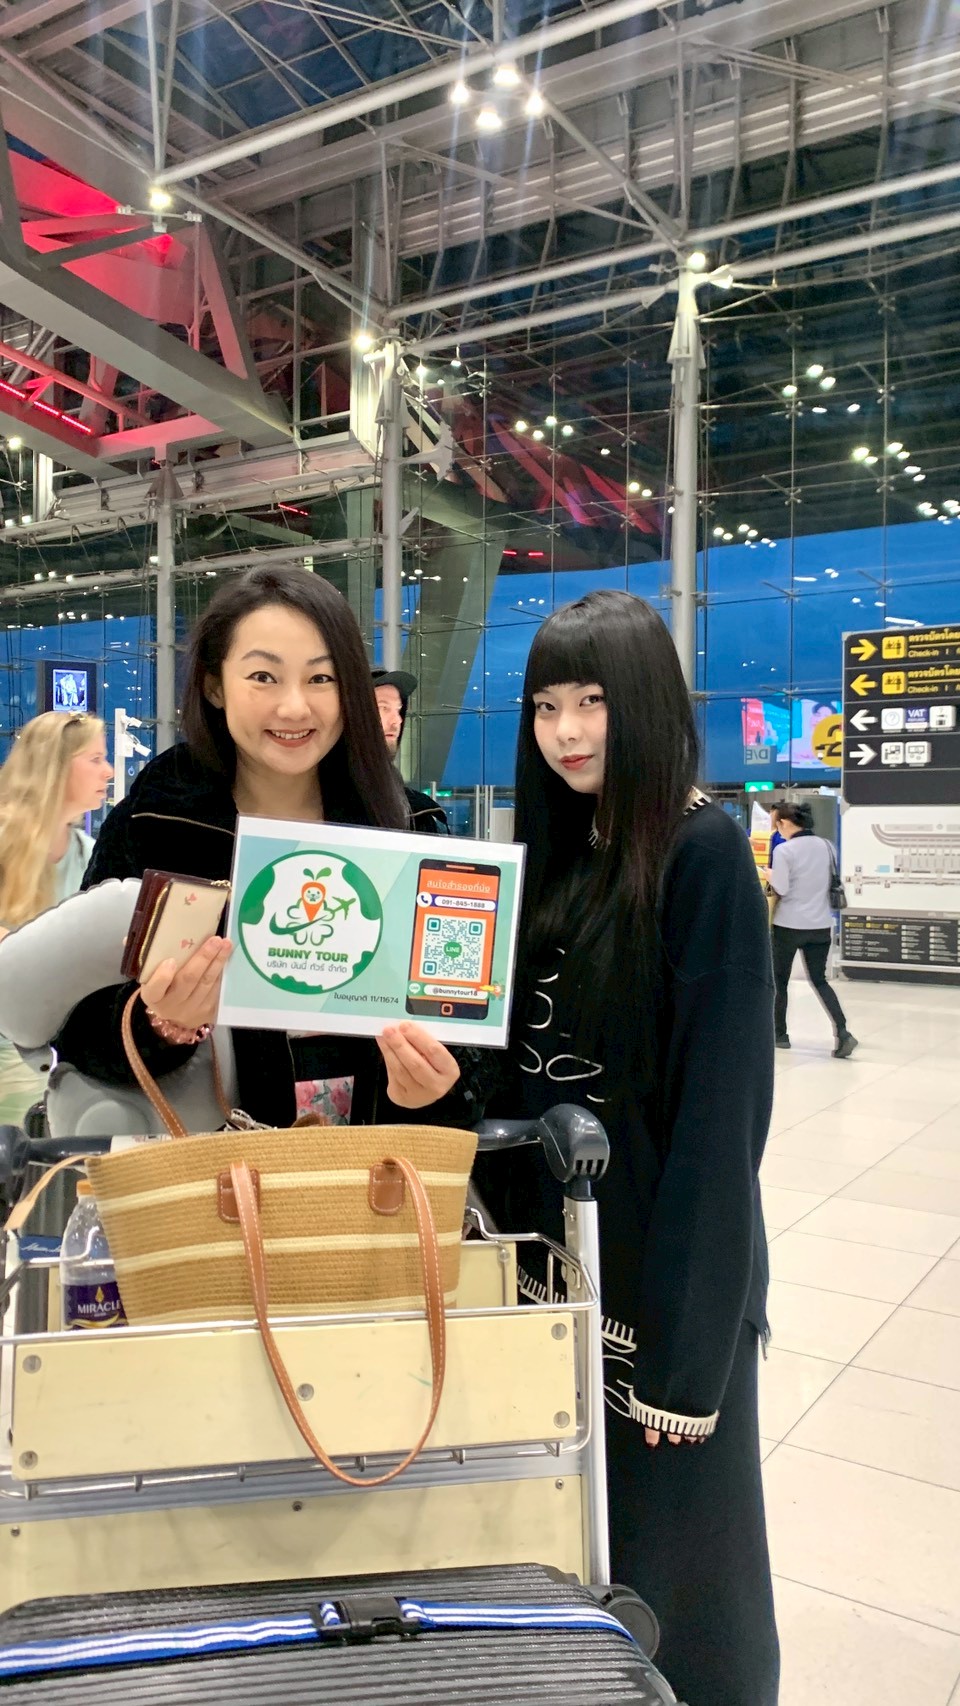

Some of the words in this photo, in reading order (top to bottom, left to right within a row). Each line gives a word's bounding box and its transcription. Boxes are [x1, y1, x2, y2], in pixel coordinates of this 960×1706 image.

[907, 708, 927, 718] VAT
[441, 899, 486, 909] 091-845-1888
[268, 947, 311, 960] BUNNY
[315, 951, 349, 962] TOUR
[266, 959, 288, 969] บริษัท
[310, 962, 325, 972] ทัวร์
[328, 963, 348, 973] จำกัด
[432, 987, 478, 997] @bunnytour18
[370, 995, 399, 1004] 11/11674
